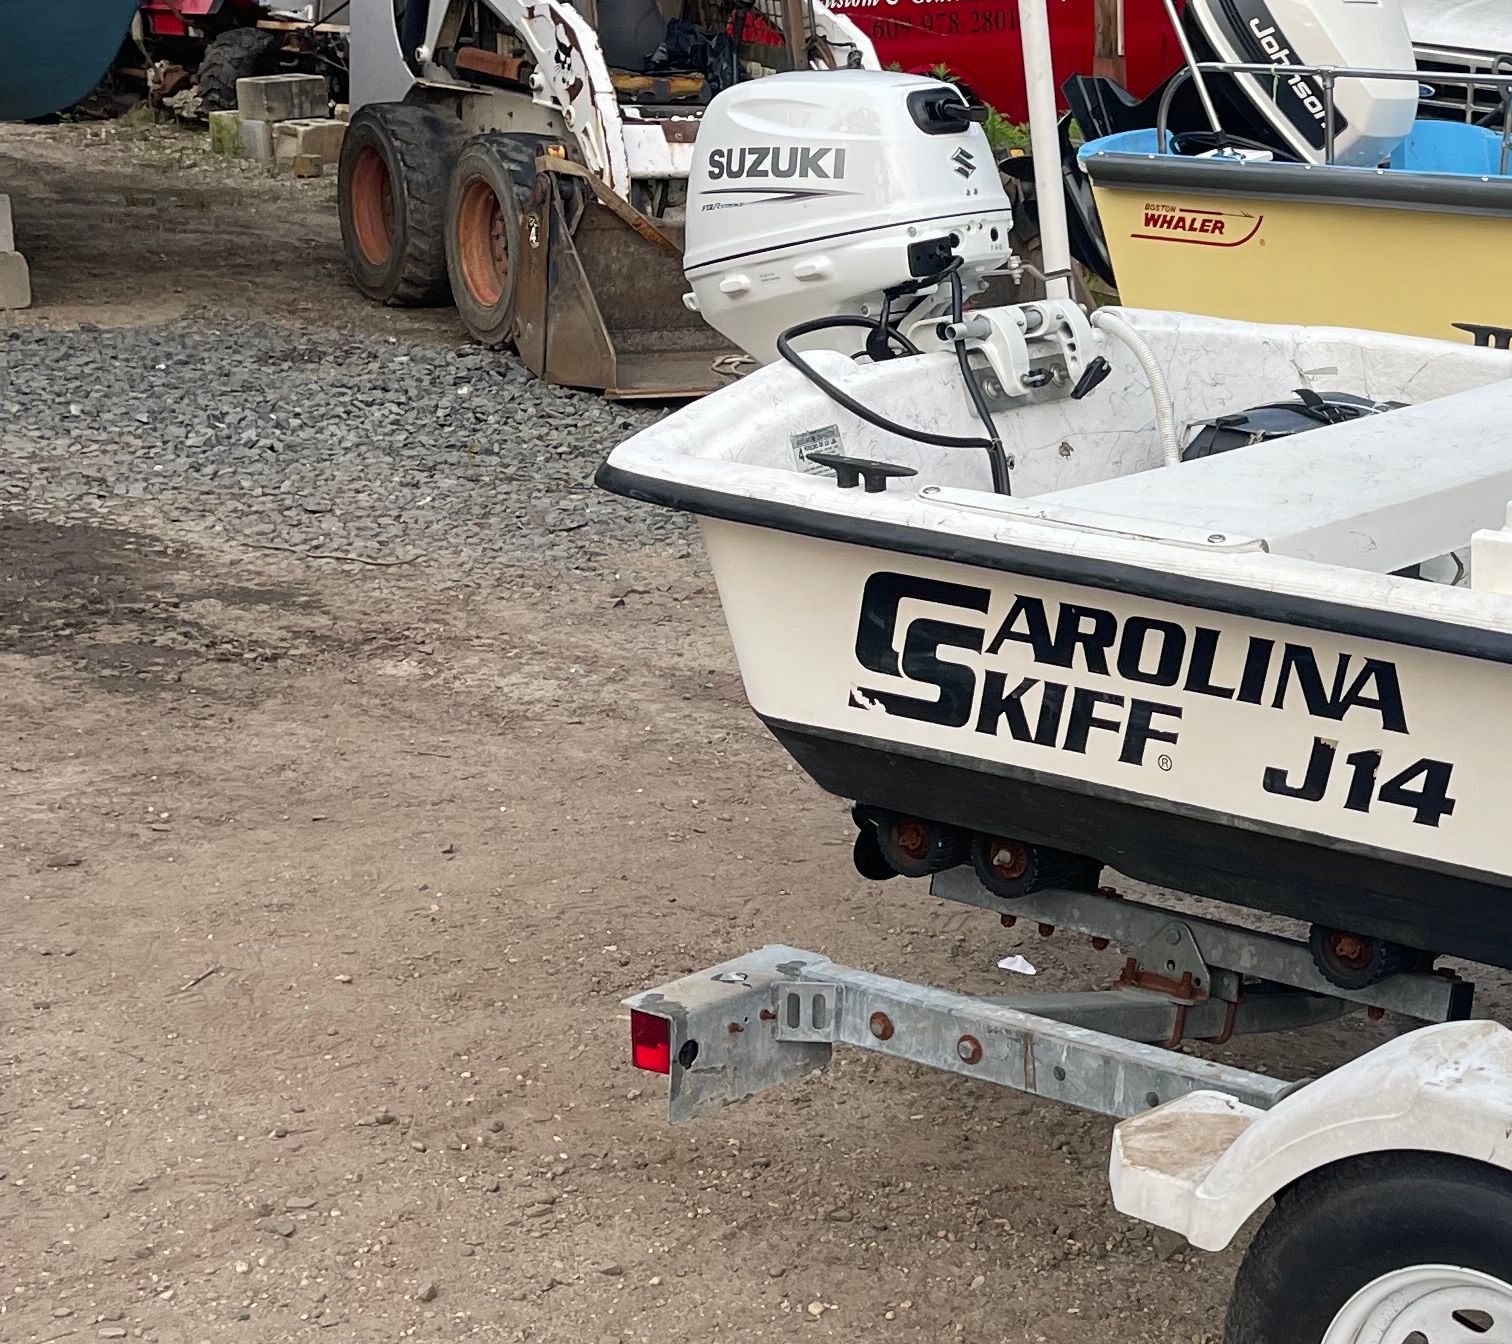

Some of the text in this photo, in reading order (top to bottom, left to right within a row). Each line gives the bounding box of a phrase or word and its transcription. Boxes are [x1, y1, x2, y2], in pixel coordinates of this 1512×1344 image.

[707, 146, 847, 181] SUZUKI
[1143, 212, 1226, 235] WHALER
[1144, 203, 1177, 213] BOSTON
[855, 570, 1410, 735] CAROLINA
[1262, 736, 1456, 828] J14
